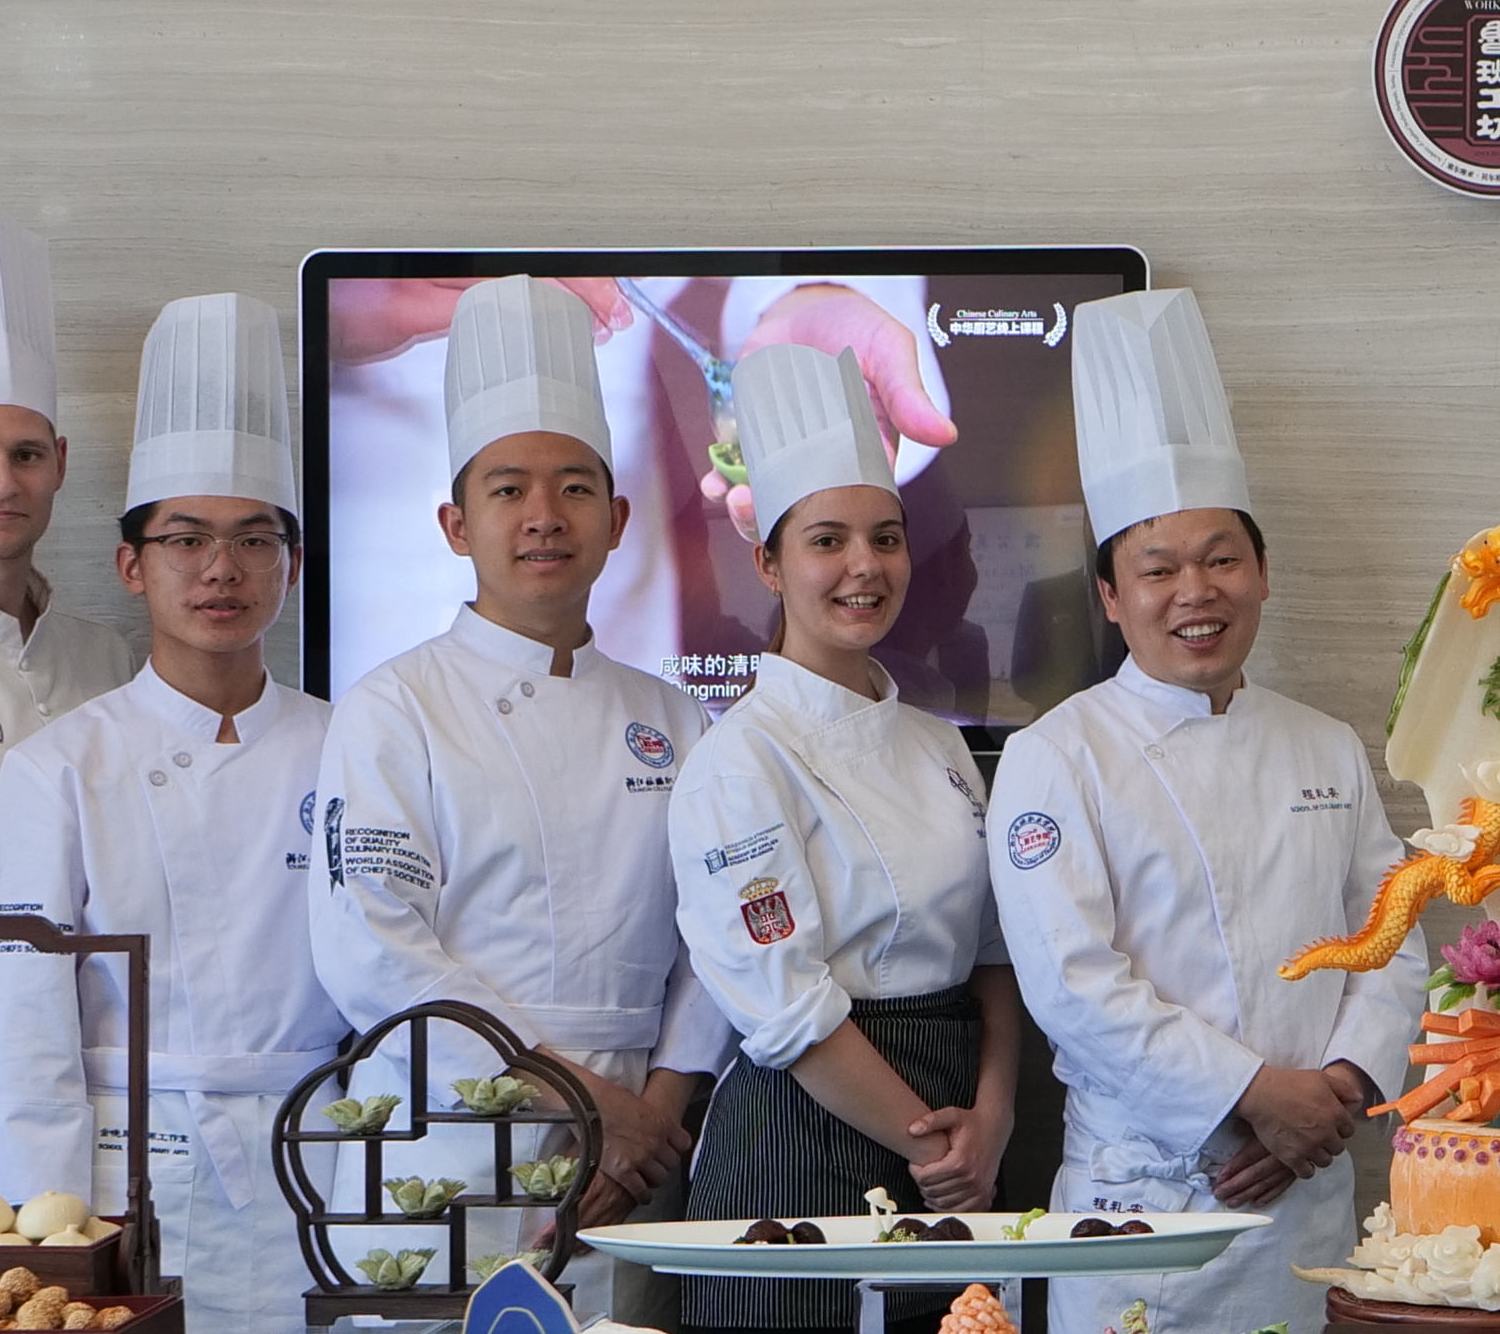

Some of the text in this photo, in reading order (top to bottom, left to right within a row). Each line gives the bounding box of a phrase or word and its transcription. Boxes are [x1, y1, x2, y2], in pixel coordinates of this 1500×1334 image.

[956, 310, 1038, 319] Chinese Culinary Arts
[345, 828, 411, 840] RECOGNITION
[345, 836, 401, 848] OF QUALITY
[345, 845, 391, 855] CULINARY
[345, 856, 384, 866] WORLD
[345, 866, 359, 875] OF
[98, 1143, 190, 1156] SCHOOL ARTS
